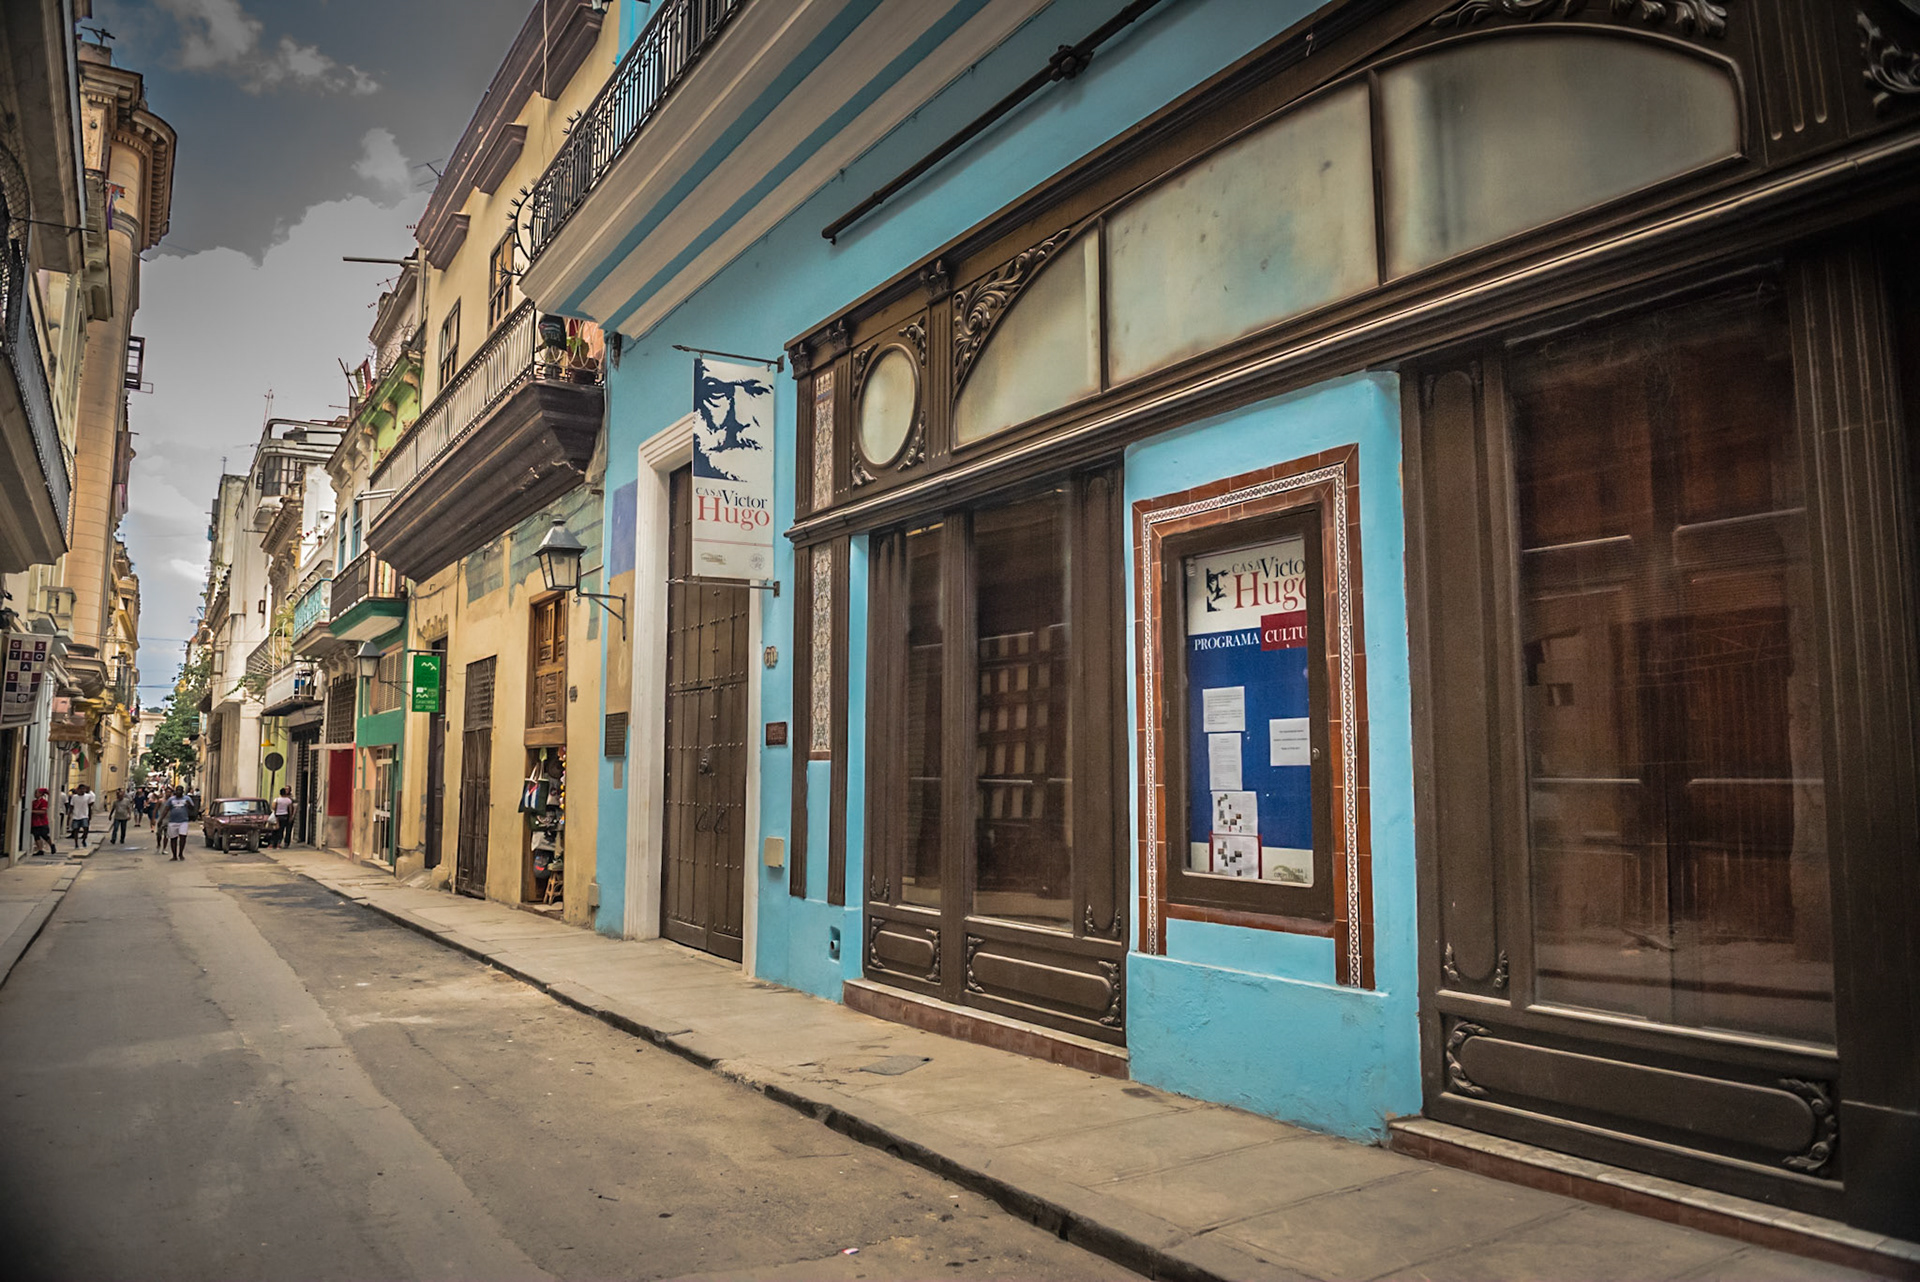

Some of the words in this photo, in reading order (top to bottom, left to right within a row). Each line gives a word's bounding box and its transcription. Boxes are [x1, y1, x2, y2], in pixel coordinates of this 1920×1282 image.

[695, 487, 722, 497] CASA
[722, 489, 768, 509] Victor
[697, 495, 770, 532] Hugo
[1232, 560, 1261, 574] CASA
[1194, 632, 1260, 652] PROGRAMA
